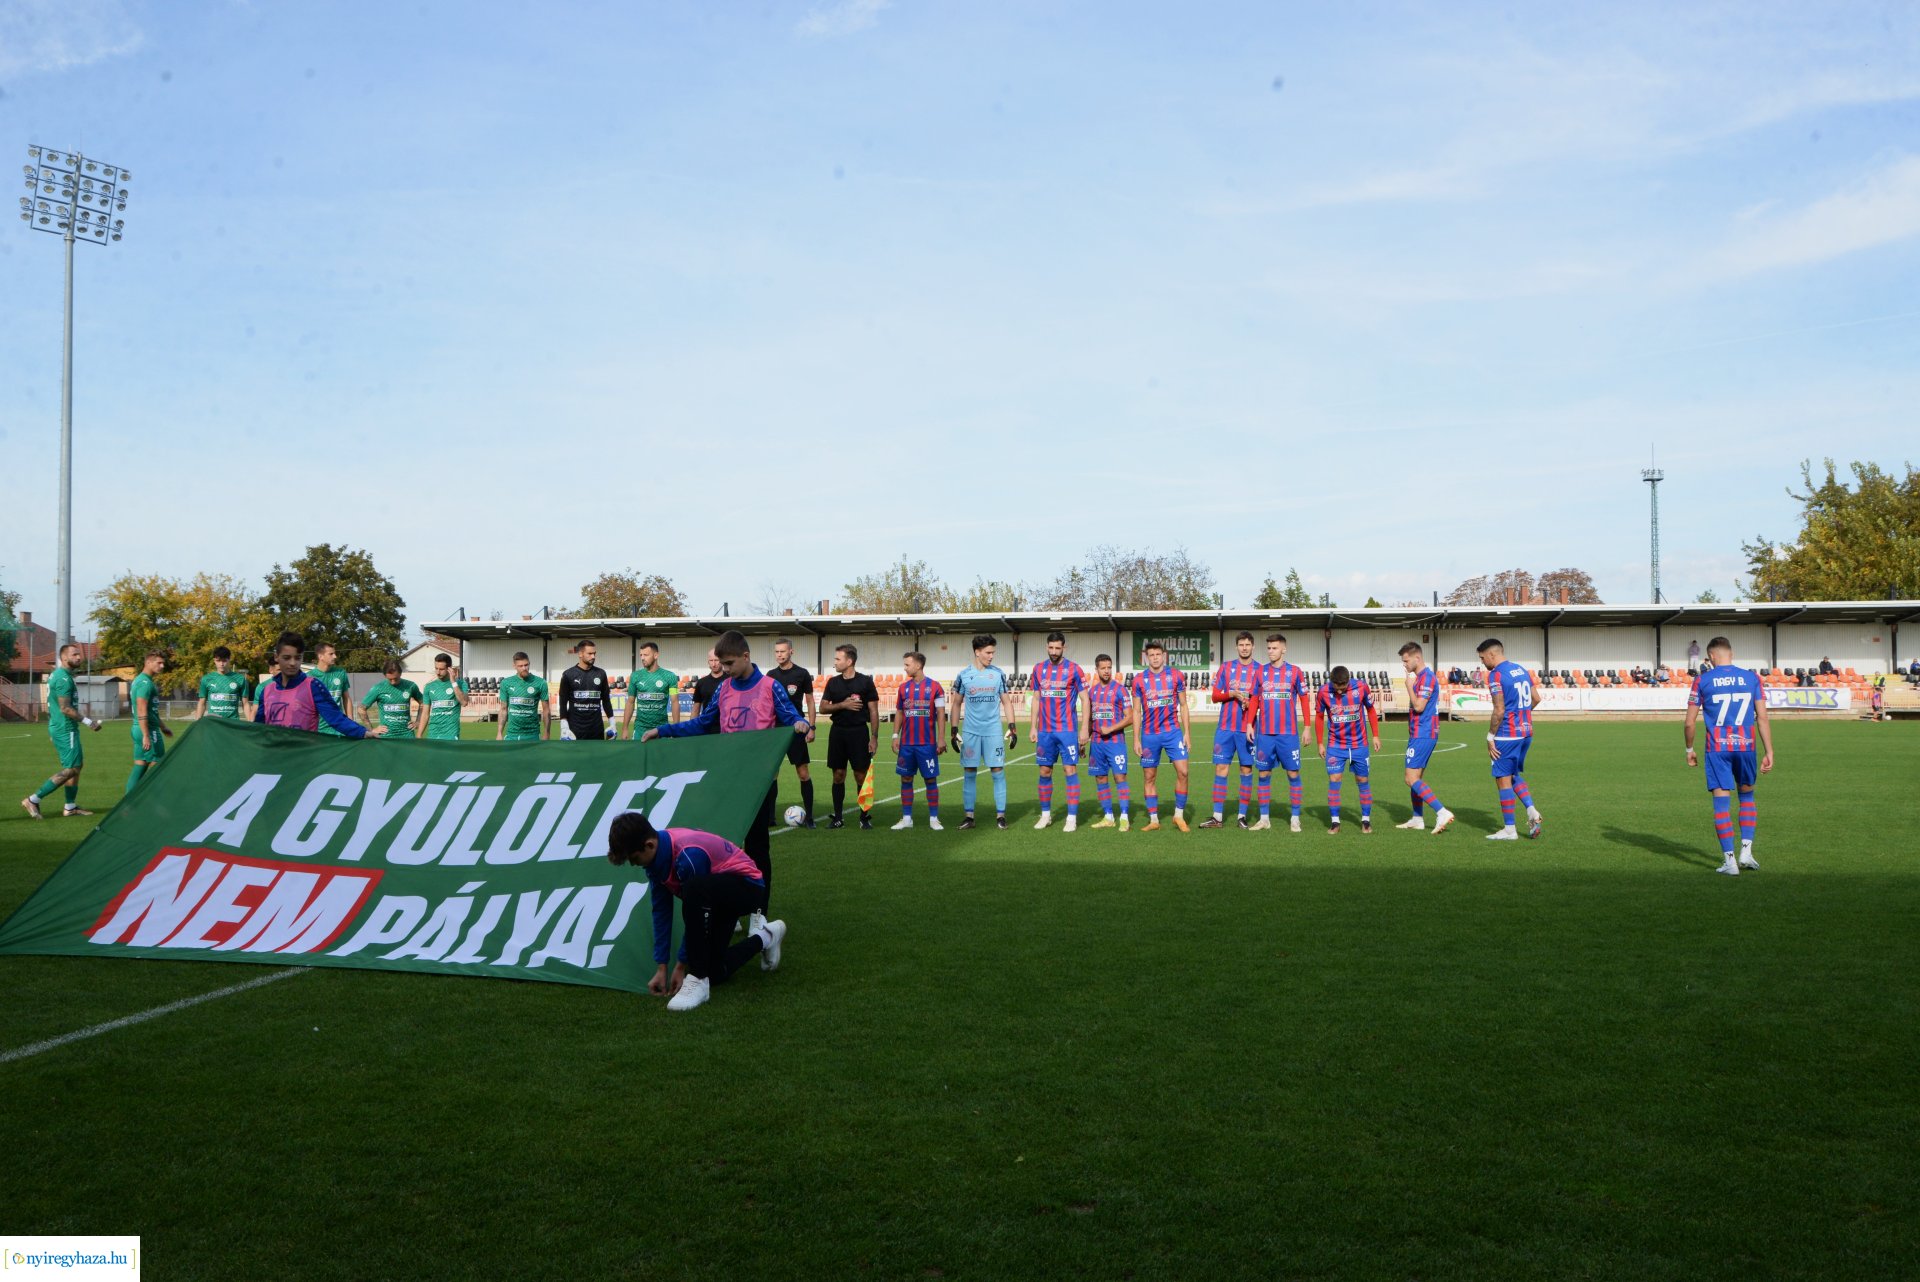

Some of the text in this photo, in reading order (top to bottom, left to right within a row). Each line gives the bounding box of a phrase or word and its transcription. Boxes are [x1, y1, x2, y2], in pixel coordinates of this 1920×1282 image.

[1513, 680, 1532, 709] 19
[1712, 677, 1736, 687] NAGY
[1712, 692, 1752, 727] 77
[926, 758, 935, 769] 14
[995, 747, 1004, 757] 57
[182, 770, 707, 866] A GYŰLÖLET
[87, 853, 650, 969] NEM PÁLYA!
